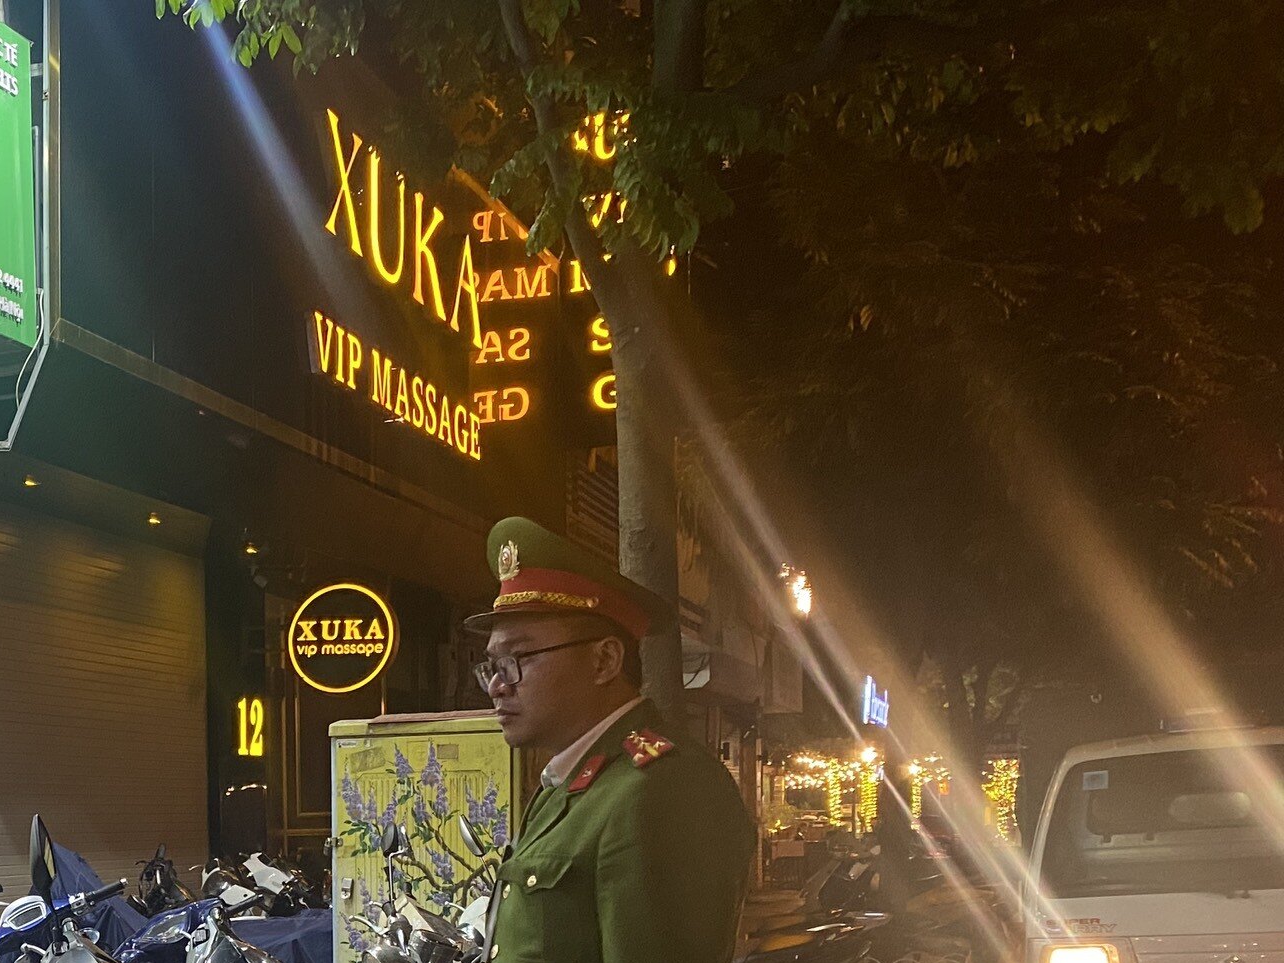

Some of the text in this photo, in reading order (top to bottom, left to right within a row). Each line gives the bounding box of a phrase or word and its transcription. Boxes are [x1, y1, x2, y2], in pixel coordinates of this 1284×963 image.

[4, 43, 18, 67] TẾ
[324, 108, 483, 350] XUKA
[314, 310, 482, 461] VIP MASSAGE
[296, 618, 385, 642] XUKA
[296, 644, 318, 658] vip
[237, 697, 264, 757] 12
